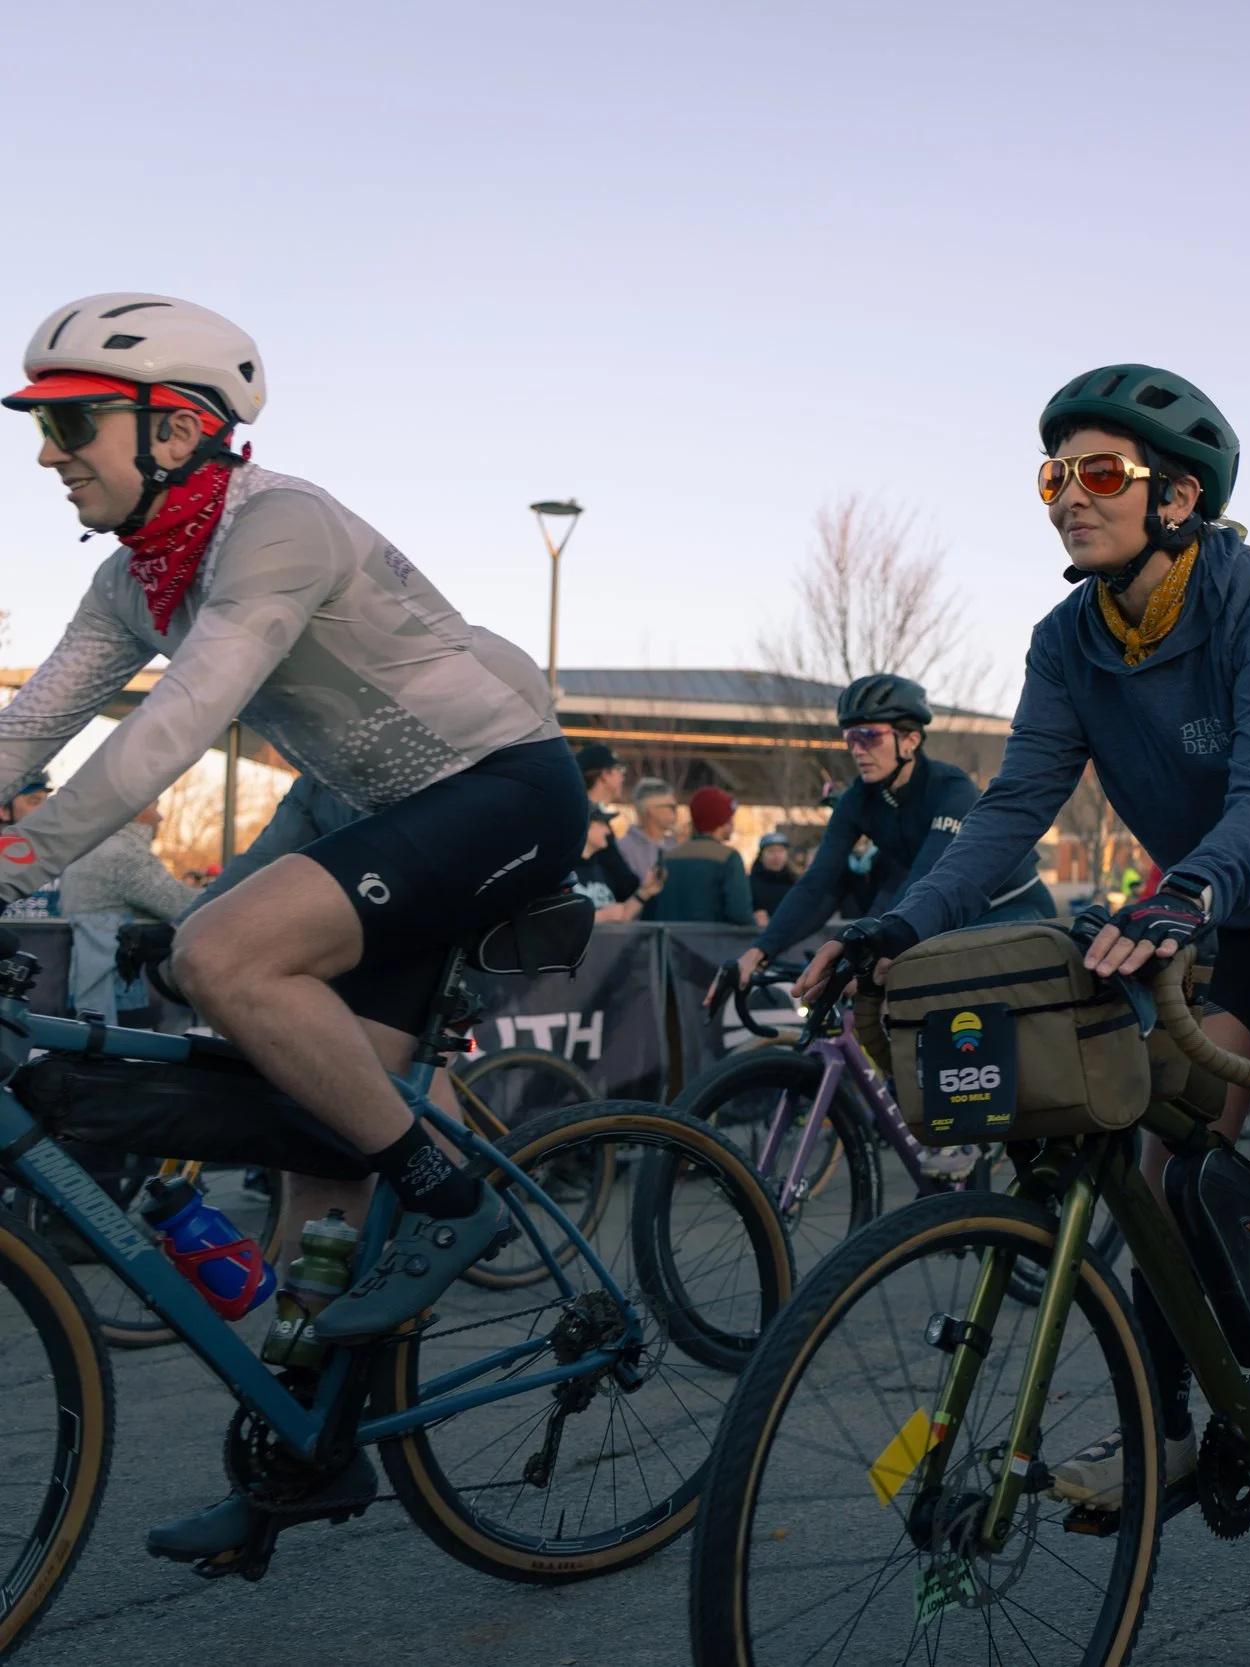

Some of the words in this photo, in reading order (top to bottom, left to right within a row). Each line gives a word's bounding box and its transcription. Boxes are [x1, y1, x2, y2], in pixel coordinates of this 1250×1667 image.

[939, 1065, 1001, 1092] 526
[949, 1094, 968, 1103] 100
[969, 1092, 991, 1102] MILE
[22, 1137, 156, 1261] IAMONDBACK
